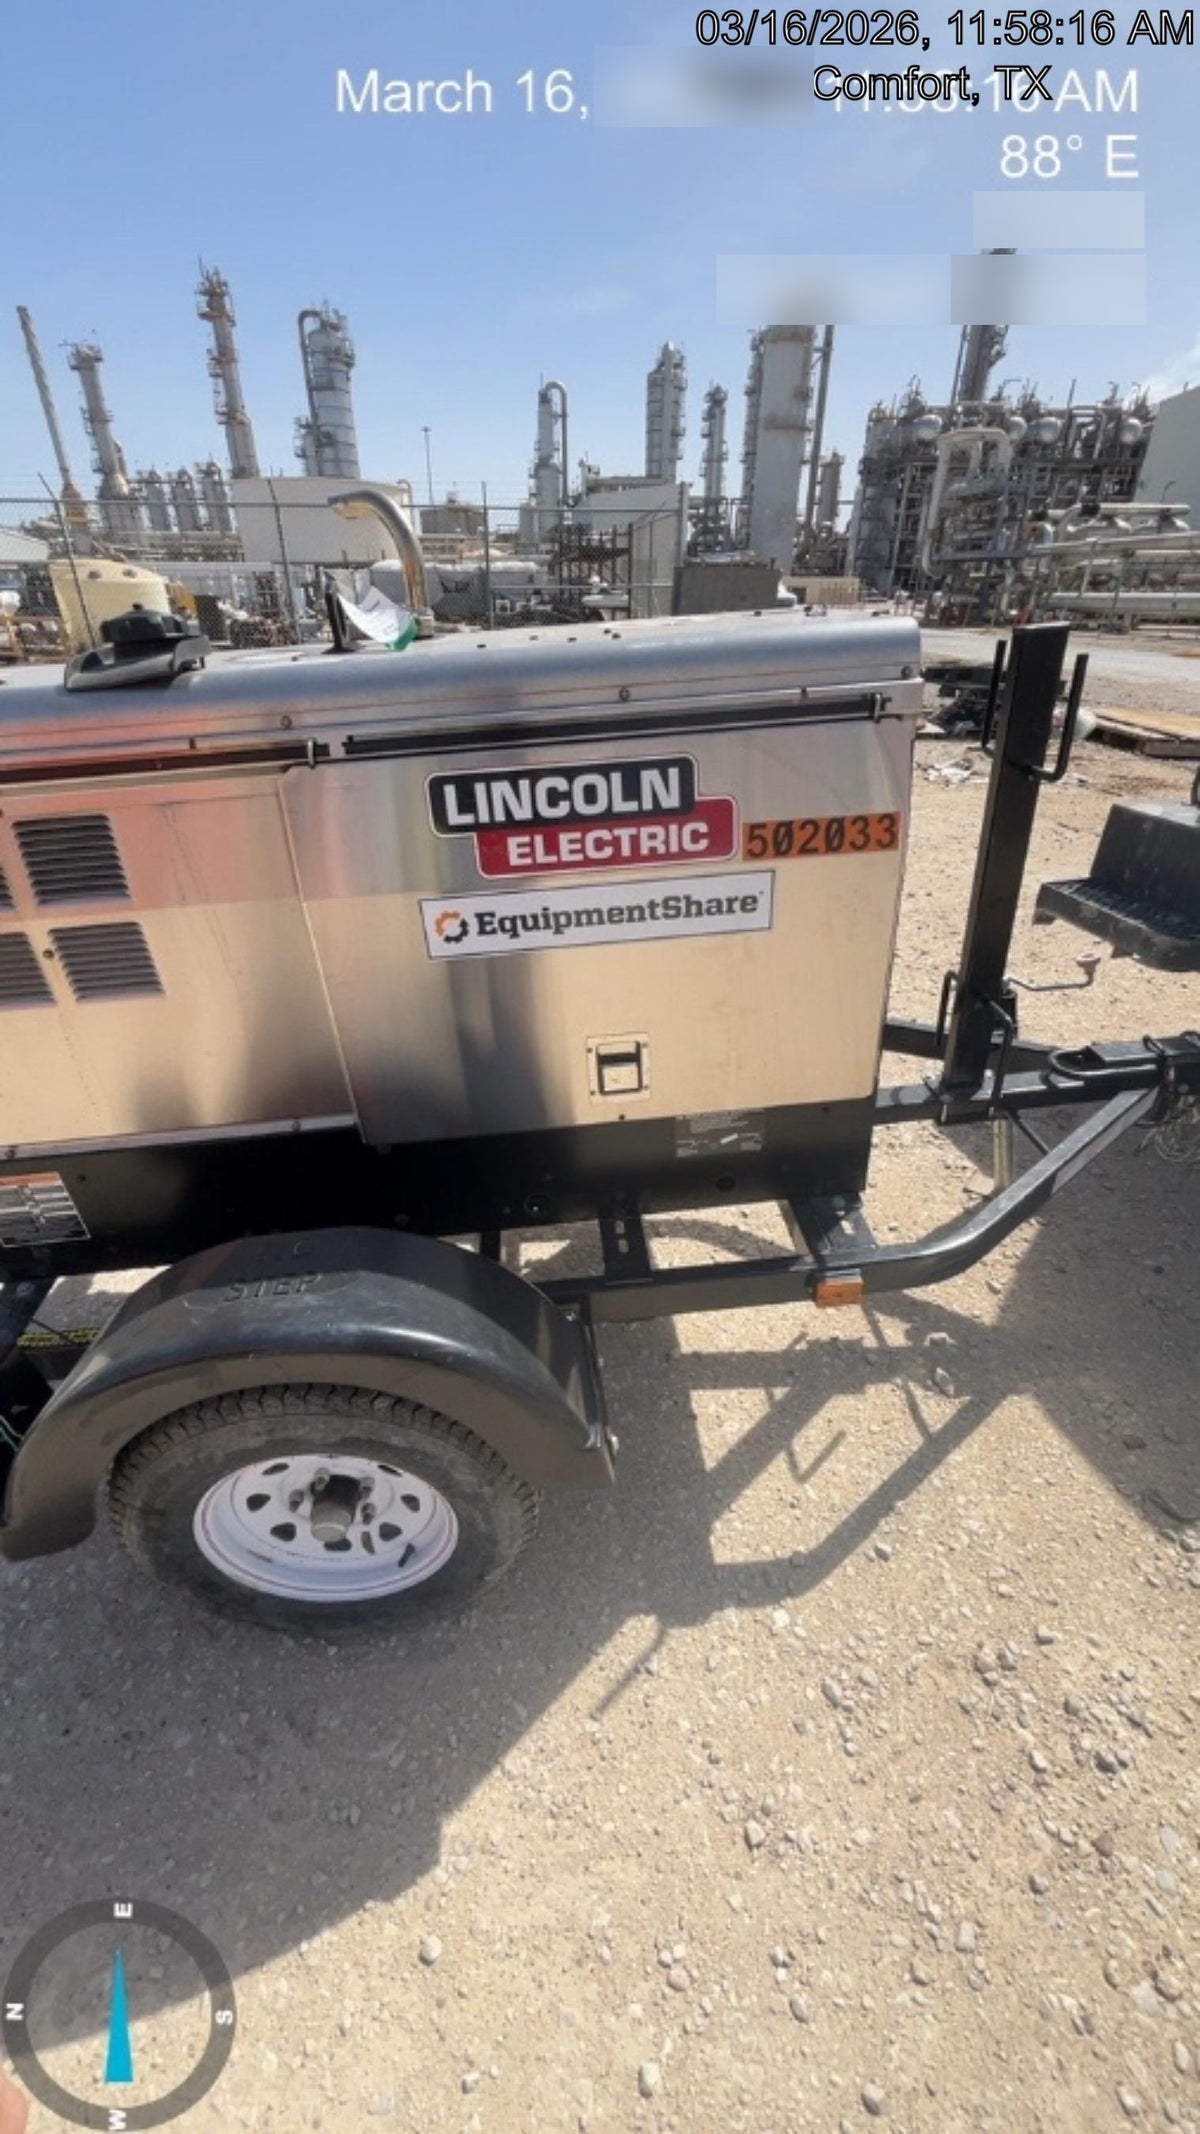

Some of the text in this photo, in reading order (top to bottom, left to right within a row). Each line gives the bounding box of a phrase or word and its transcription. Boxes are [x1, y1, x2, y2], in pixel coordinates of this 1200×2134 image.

[443, 767, 681, 827] LINCOLN
[507, 821, 710, 867] ELECTRIC
[747, 812, 897, 858] 502033
[475, 893, 759, 940] EquipmentShare
[224, 1271, 322, 1302] STEP
